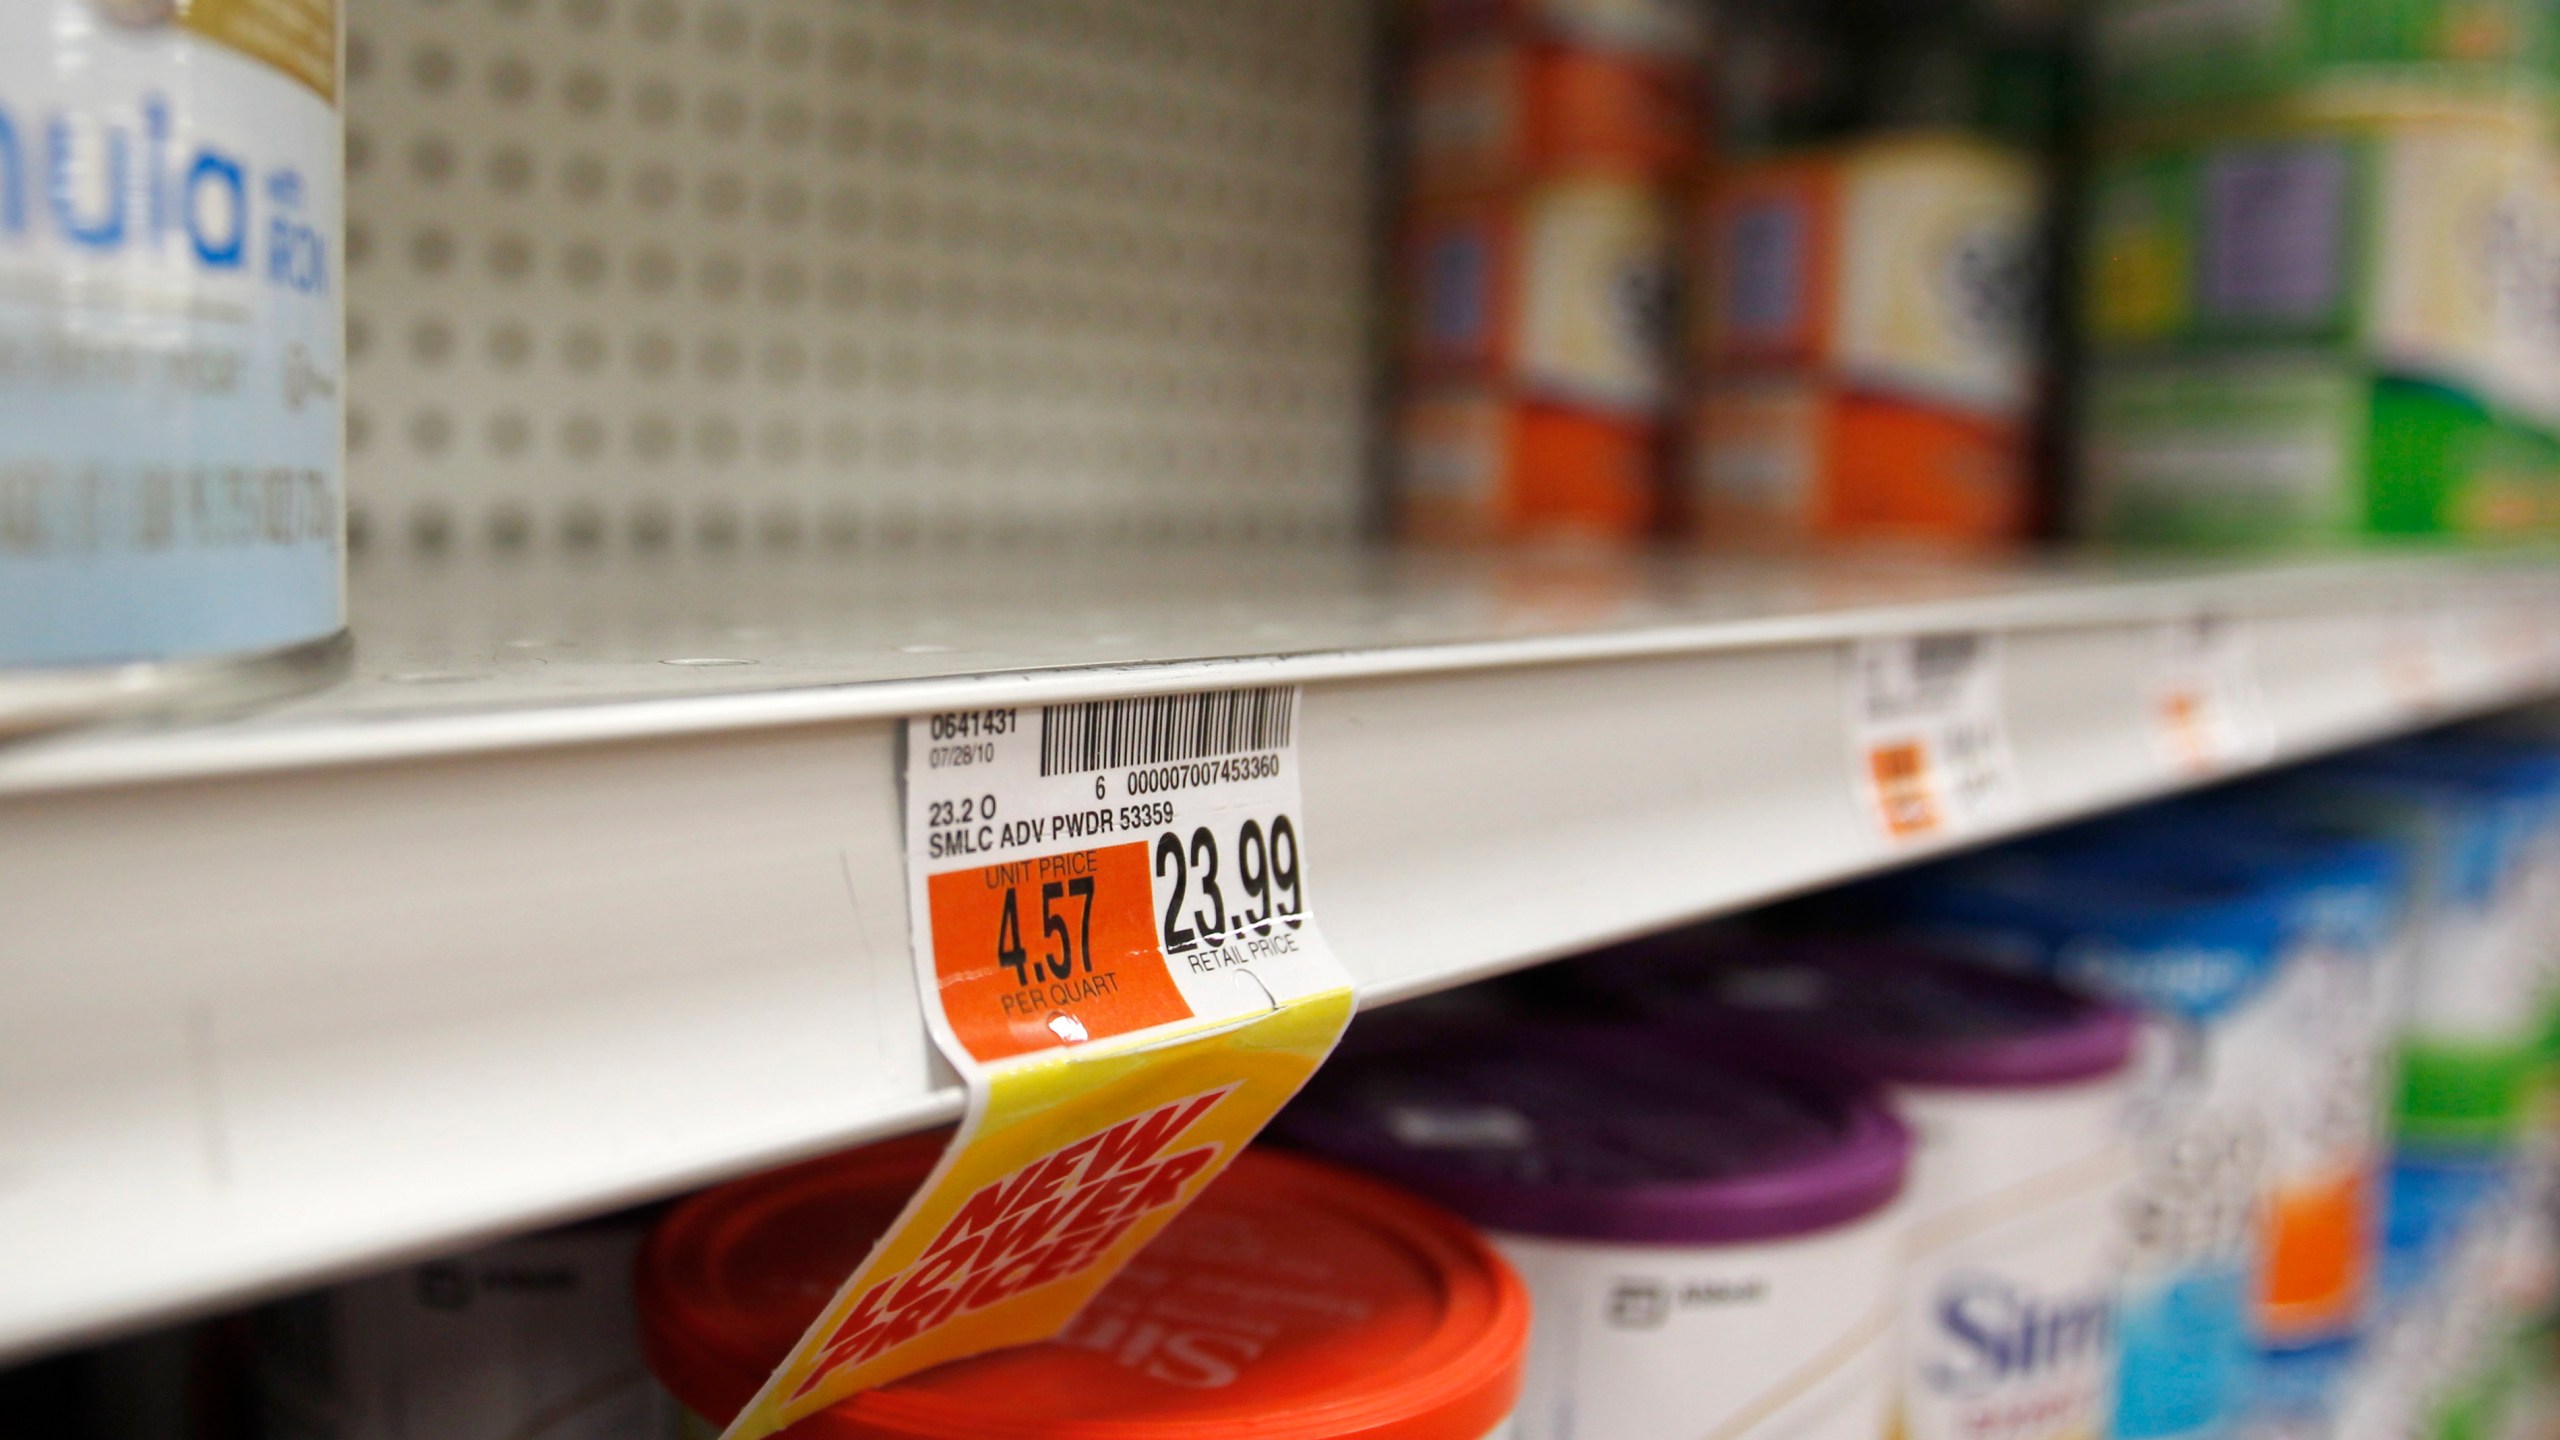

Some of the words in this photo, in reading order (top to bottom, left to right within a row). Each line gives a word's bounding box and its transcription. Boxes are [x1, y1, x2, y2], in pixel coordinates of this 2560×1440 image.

[930, 708, 1018, 741] 0641431
[929, 742, 995, 769] 07/28/10
[1095, 775, 1107, 801] 6
[1127, 754, 1280, 796] 000007007453360
[928, 825, 994, 859] SMLC
[1000, 818, 1046, 849] ADV
[1052, 808, 1115, 841] PWDR
[1120, 801, 1175, 831] 53359
[929, 797, 973, 828] 23.2
[985, 859, 1031, 890] UNIT
[1040, 850, 1098, 876] PRICE
[1155, 814, 1303, 956] 23.99
[996, 875, 1097, 987] 4.57
[1187, 944, 1249, 975] RETAIL
[1251, 933, 1299, 960] PRICE
[1002, 986, 1047, 1016] PER
[1050, 971, 1119, 1007] QUART
[919, 1087, 1232, 1262] NEW
[820, 1143, 1219, 1354] LOWER
